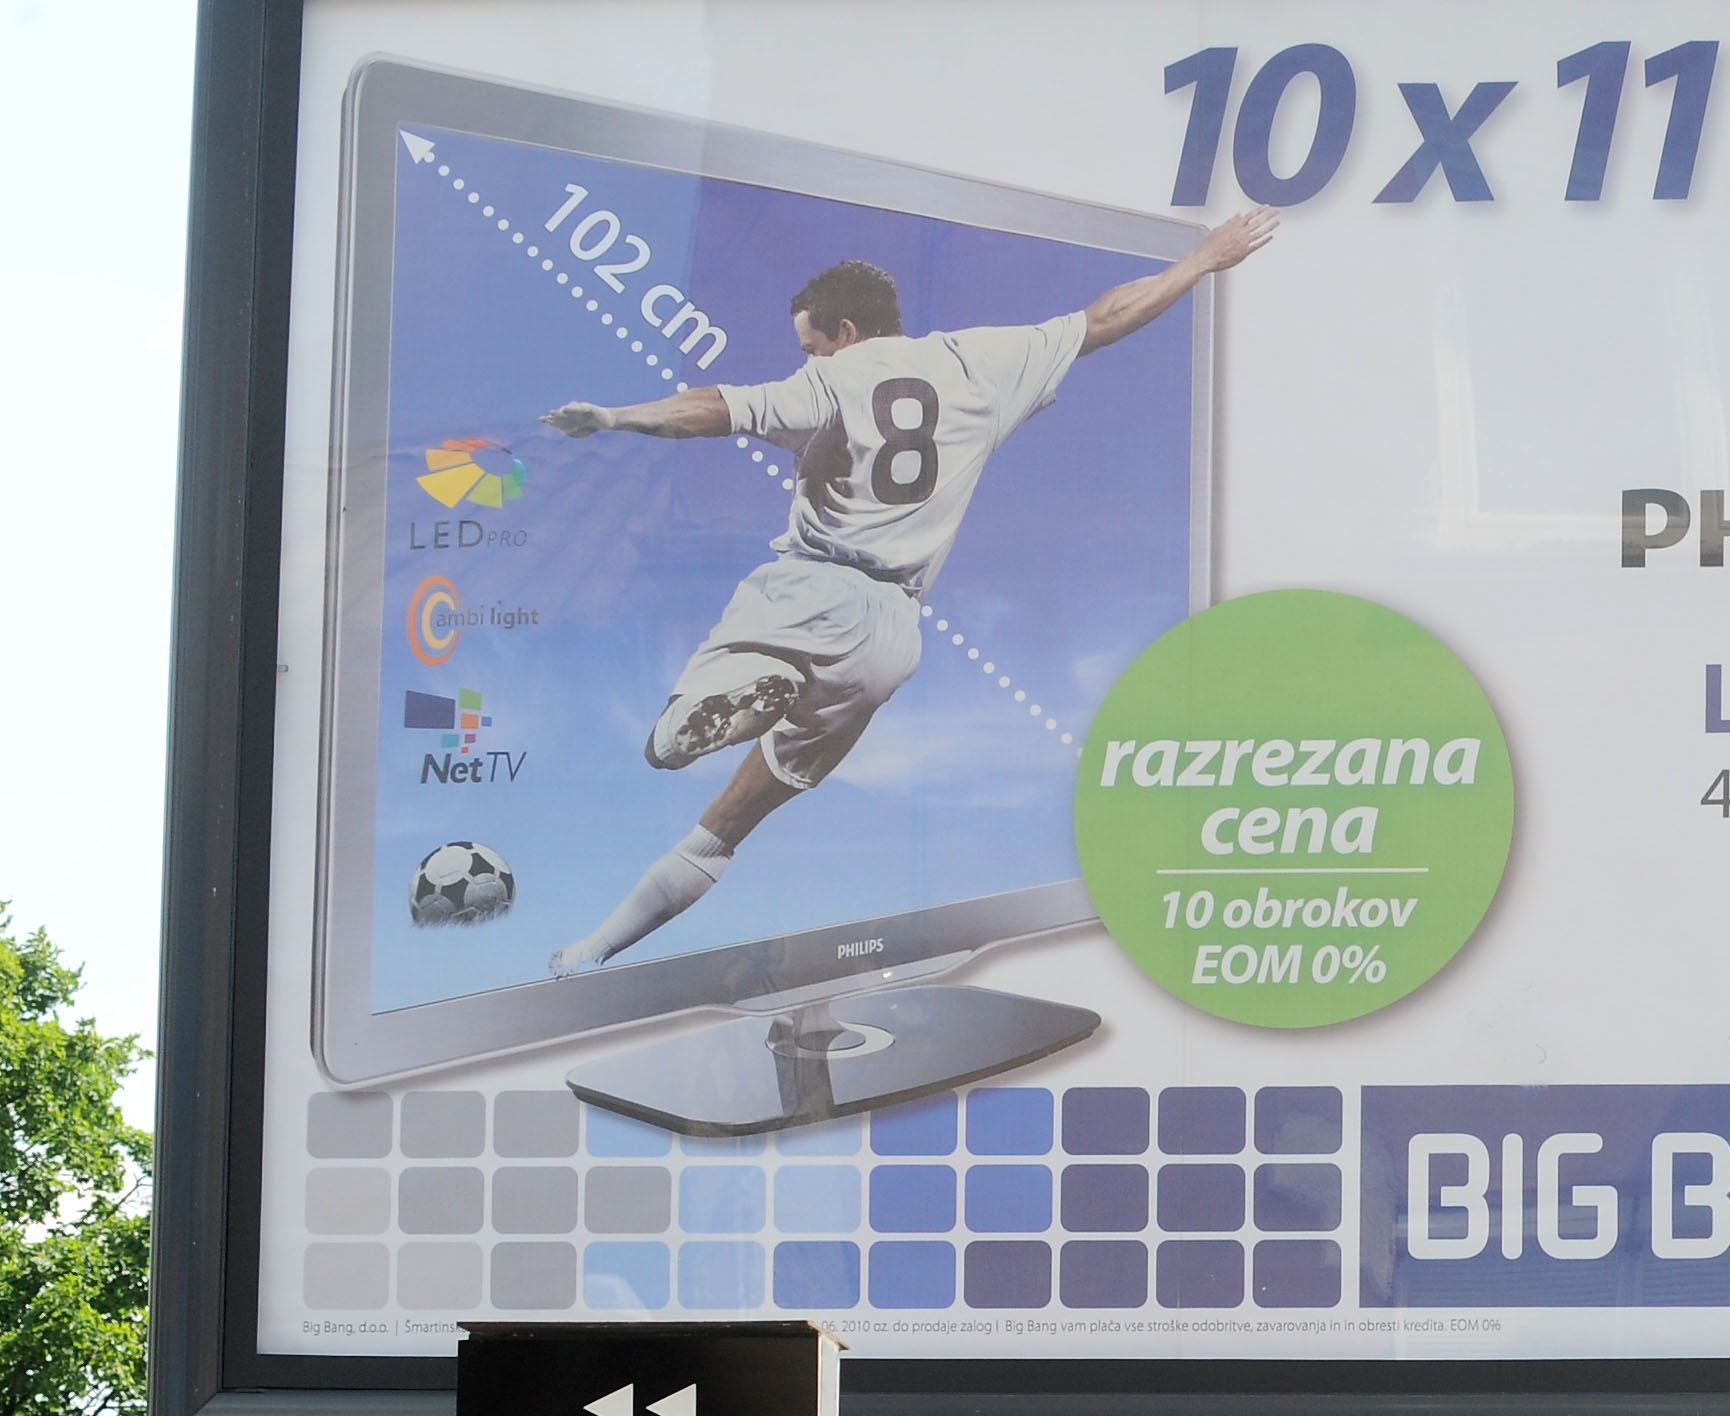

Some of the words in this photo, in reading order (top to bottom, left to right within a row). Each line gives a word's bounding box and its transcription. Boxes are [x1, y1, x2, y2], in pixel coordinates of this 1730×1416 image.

[1162, 43, 1357, 208] 10
[1371, 82, 1518, 204] x
[541, 182, 653, 295] 102
[640, 280, 730, 371] cm
[870, 377, 940, 505] 8
[1100, 733, 1481, 790] razrezana
[1199, 801, 1377, 856] cena
[1162, 889, 1212, 929] 10
[1223, 888, 1417, 930] obrokov
[837, 938, 884, 959] PHILIPS
[1191, 944, 1302, 986] EOM
[1311, 944, 1387, 986] 0%
[1406, 1131, 1619, 1260] BIG
[303, 1320, 320, 1335] Big
[842, 1320, 870, 1333] 2010
[893, 1320, 909, 1333] do
[912, 1320, 957, 1337] prodaje
[960, 1320, 992, 1337] zalog
[1005, 1320, 1023, 1336] Big
[1027, 1320, 1057, 1336] Bang
[1061, 1323, 1086, 1332] vam
[1125, 1323, 1143, 1332] vse
[1147, 1318, 1188, 1332] stroške
[1256, 1319, 1326, 1336] zavarovanja
[1330, 1319, 1341, 1332] in
[1344, 1319, 1355, 1332] in
[1359, 1319, 1400, 1332] obresti
[1451, 1319, 1479, 1332] EOM
[1482, 1319, 1501, 1332] 0%
